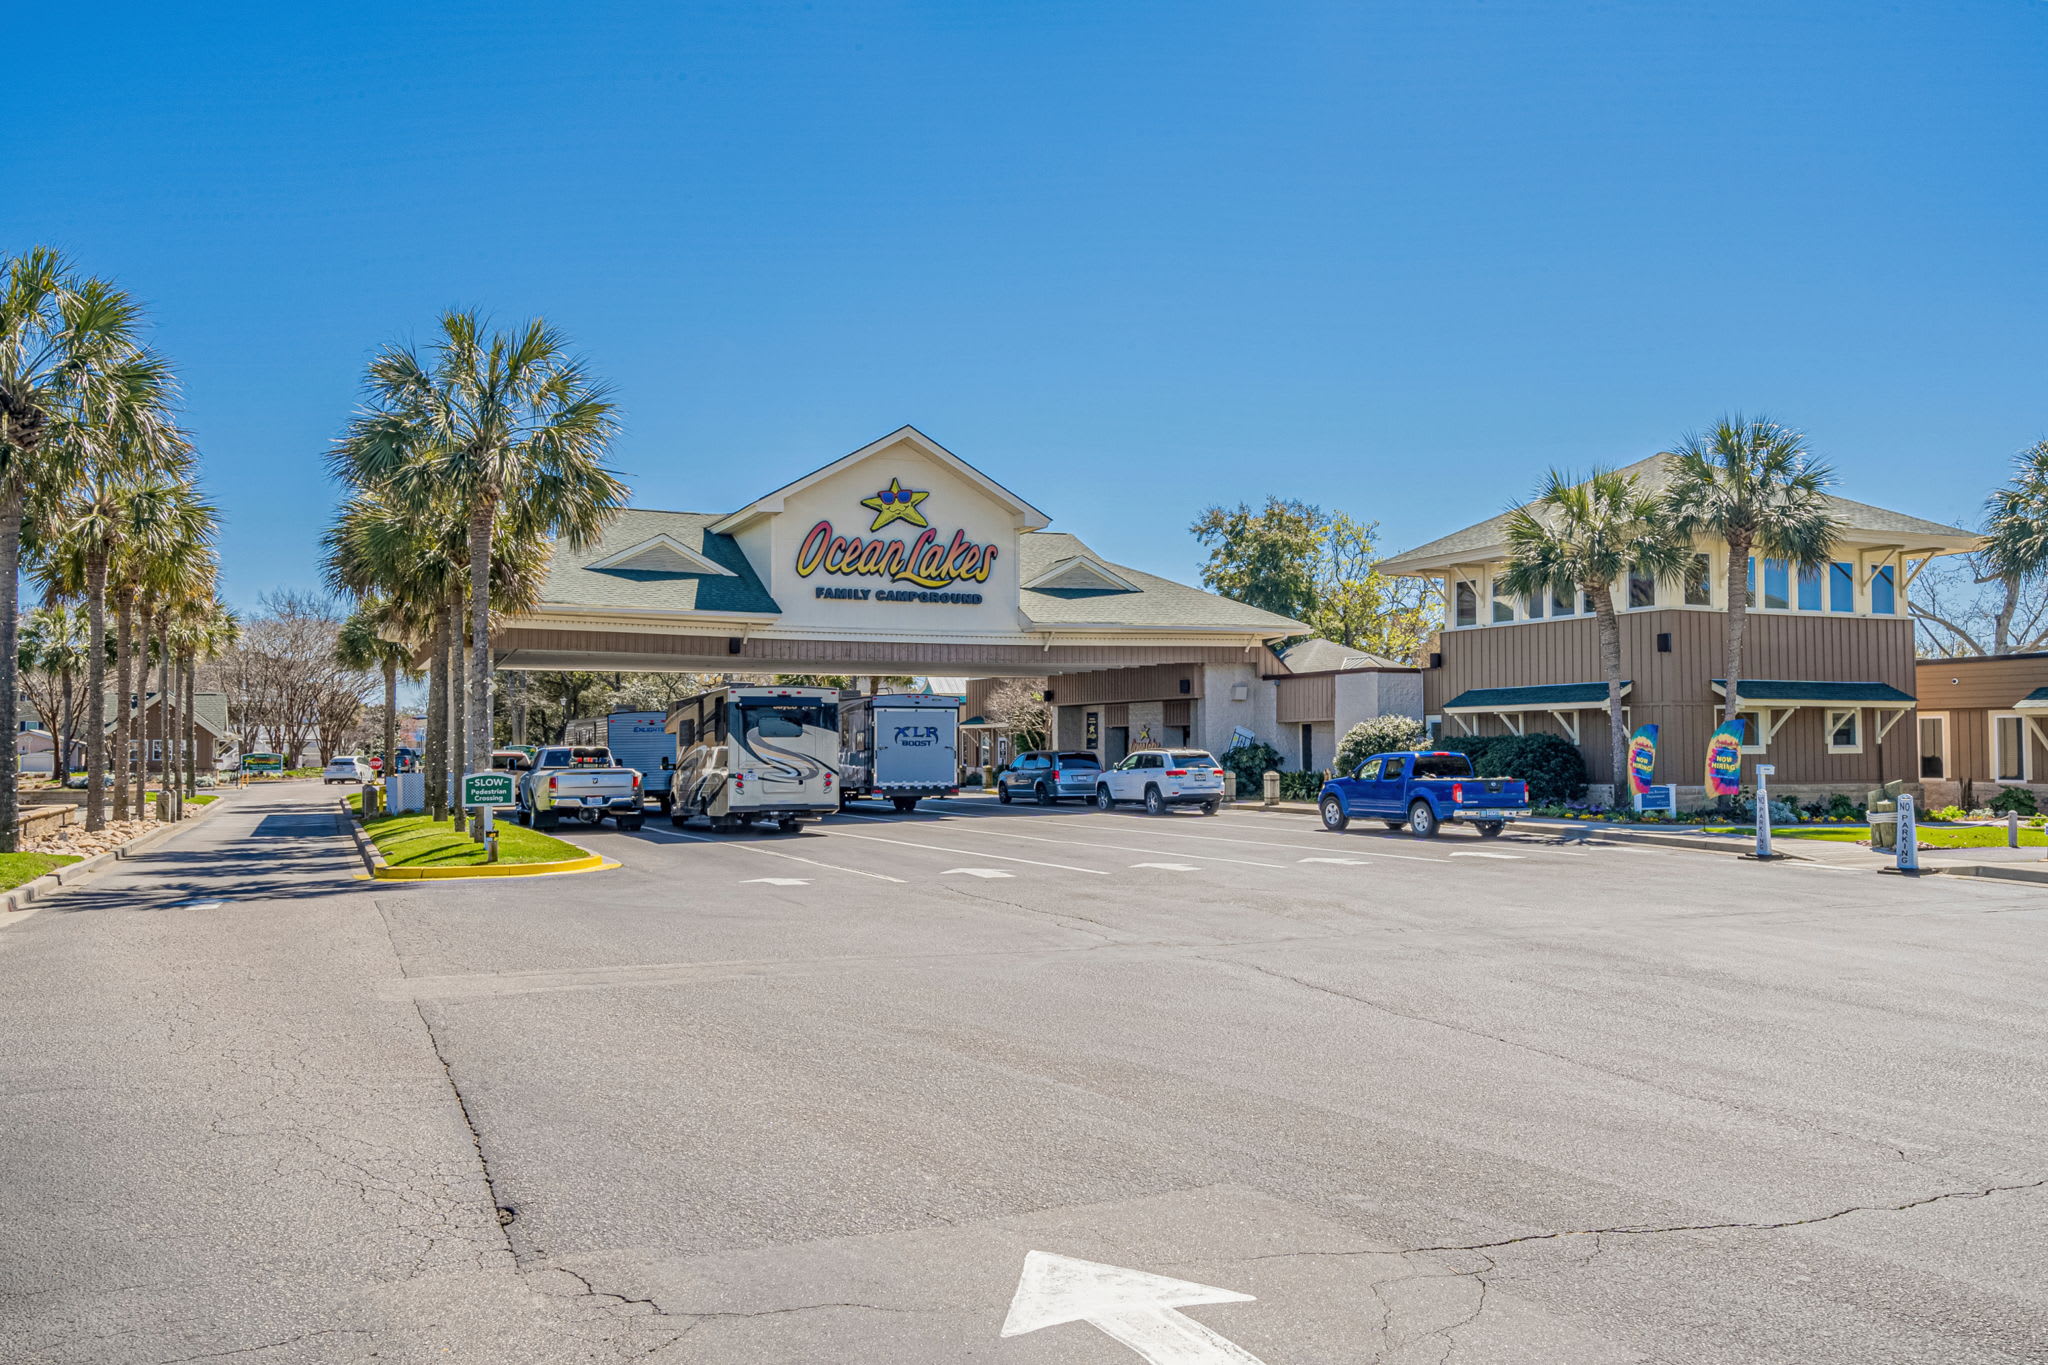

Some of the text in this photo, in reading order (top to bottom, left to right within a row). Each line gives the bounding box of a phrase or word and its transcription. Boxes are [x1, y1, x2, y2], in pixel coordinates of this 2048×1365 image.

[796, 520, 999, 590] Ocean Lakes
[815, 587, 983, 605] FAMILY CAMPGROUND
[893, 726, 939, 745] XLR
[1636, 756, 1649, 764] NOW
[1716, 755, 1732, 763] NOW
[474, 778, 504, 787] SLOW
[474, 795, 504, 803] Crossing
[1758, 796, 1765, 805] NO
[1899, 803, 1910, 811] NO
[1901, 814, 1909, 864] PARKING
